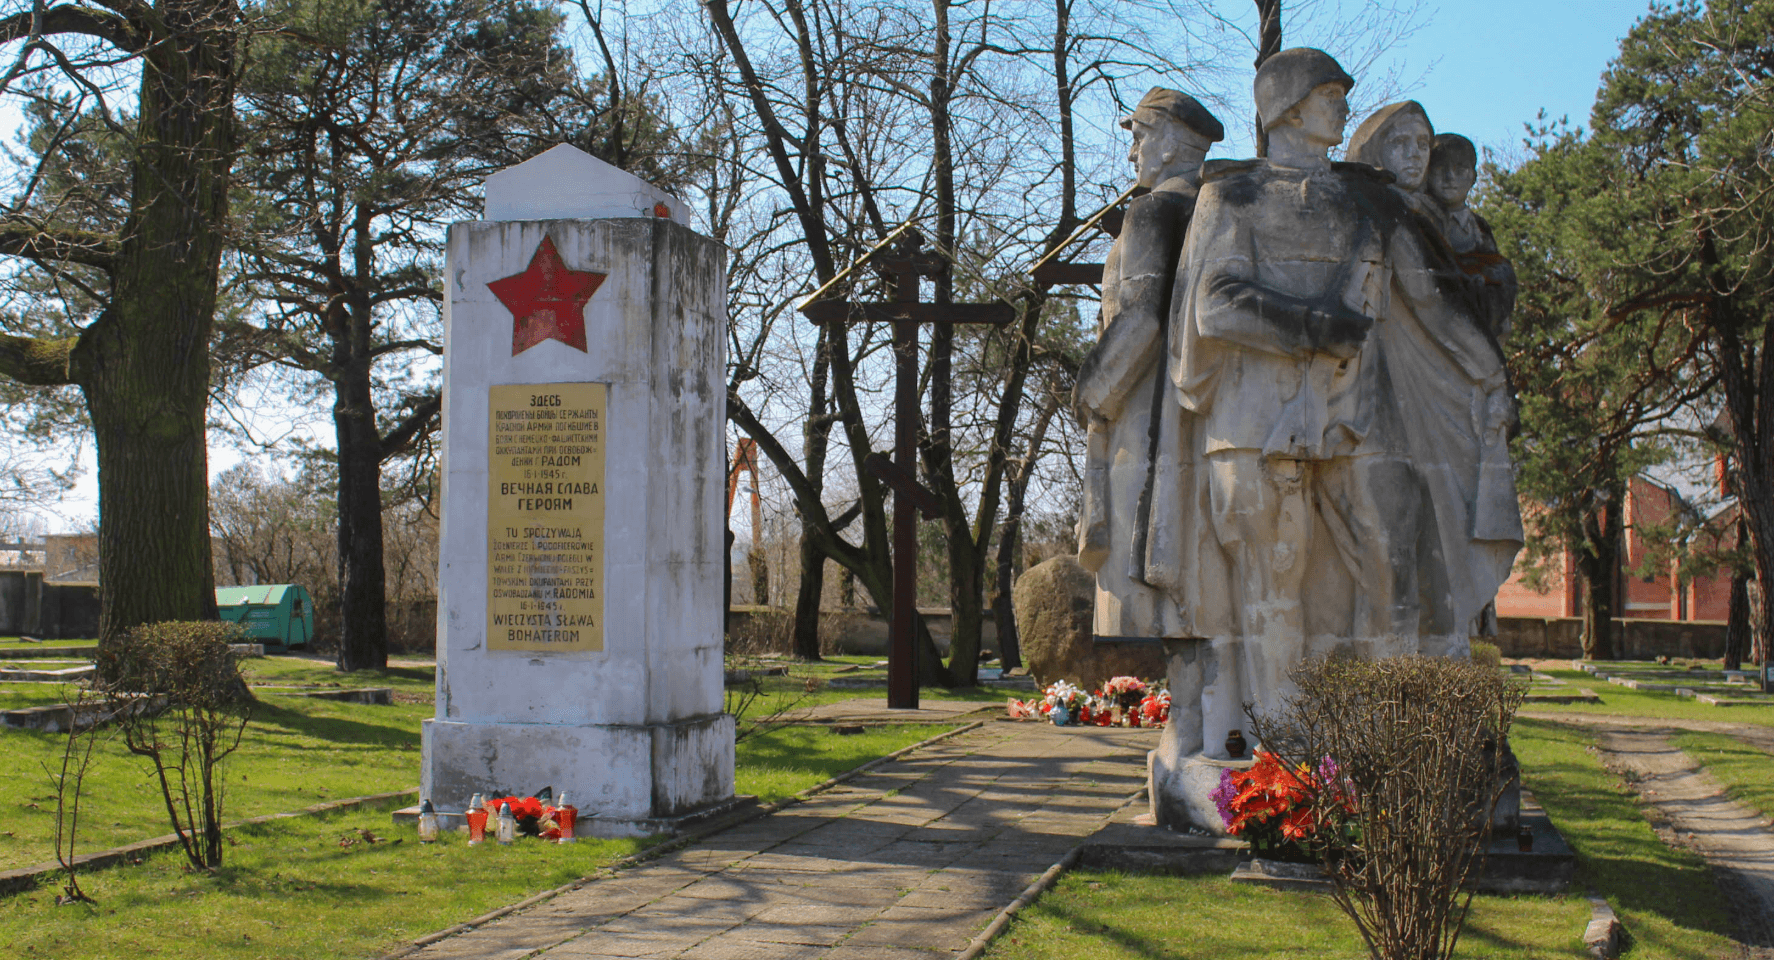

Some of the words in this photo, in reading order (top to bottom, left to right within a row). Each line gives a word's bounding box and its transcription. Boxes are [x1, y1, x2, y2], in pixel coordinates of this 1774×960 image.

[530, 394, 562, 407] ЗДЕСЬ
[541, 456, 580, 466] РАДОМ
[501, 483, 553, 495] ВЕЧНАЯ
[558, 483, 598, 494] СЛАВА
[518, 498, 572, 510] ГЕРОЯМ
[506, 528, 518, 538] TU
[523, 528, 582, 540] SPOCZYWAJĄ
[586, 554, 592, 562] W
[575, 578, 594, 587] PRZY
[553, 588, 595, 599] RADOMIA
[493, 614, 551, 626] WIECZYSTA
[556, 614, 594, 627] SŁAWA
[508, 629, 579, 642] BOHATEROM
